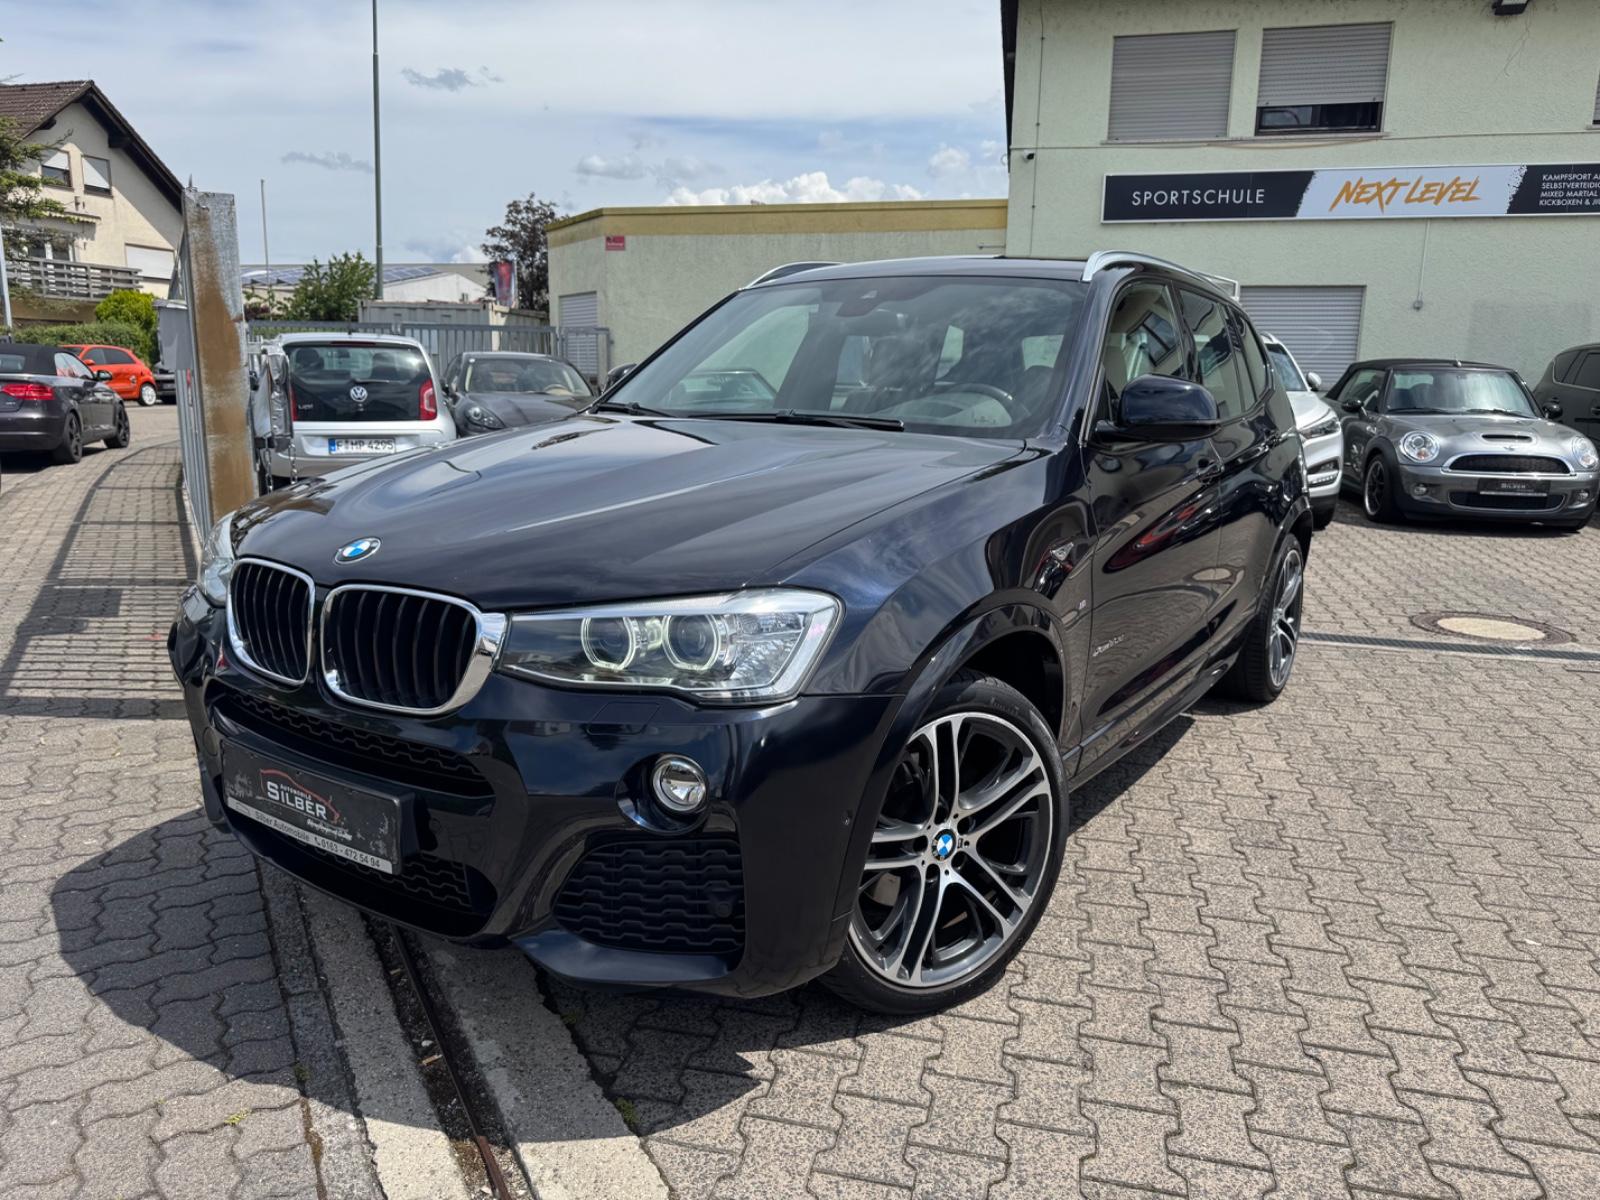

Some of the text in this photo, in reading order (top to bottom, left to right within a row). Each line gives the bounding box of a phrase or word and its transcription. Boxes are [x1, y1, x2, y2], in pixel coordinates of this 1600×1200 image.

[1542, 173, 1592, 181] KAMPFSPORT
[1131, 188, 1265, 206] SPORTSCHULE
[1328, 175, 1481, 214] NEXT LEVEL
[1540, 189, 1599, 198] MIXED MARTIAL
[1584, 198, 1591, 206] &
[266, 780, 328, 820] SILBER
